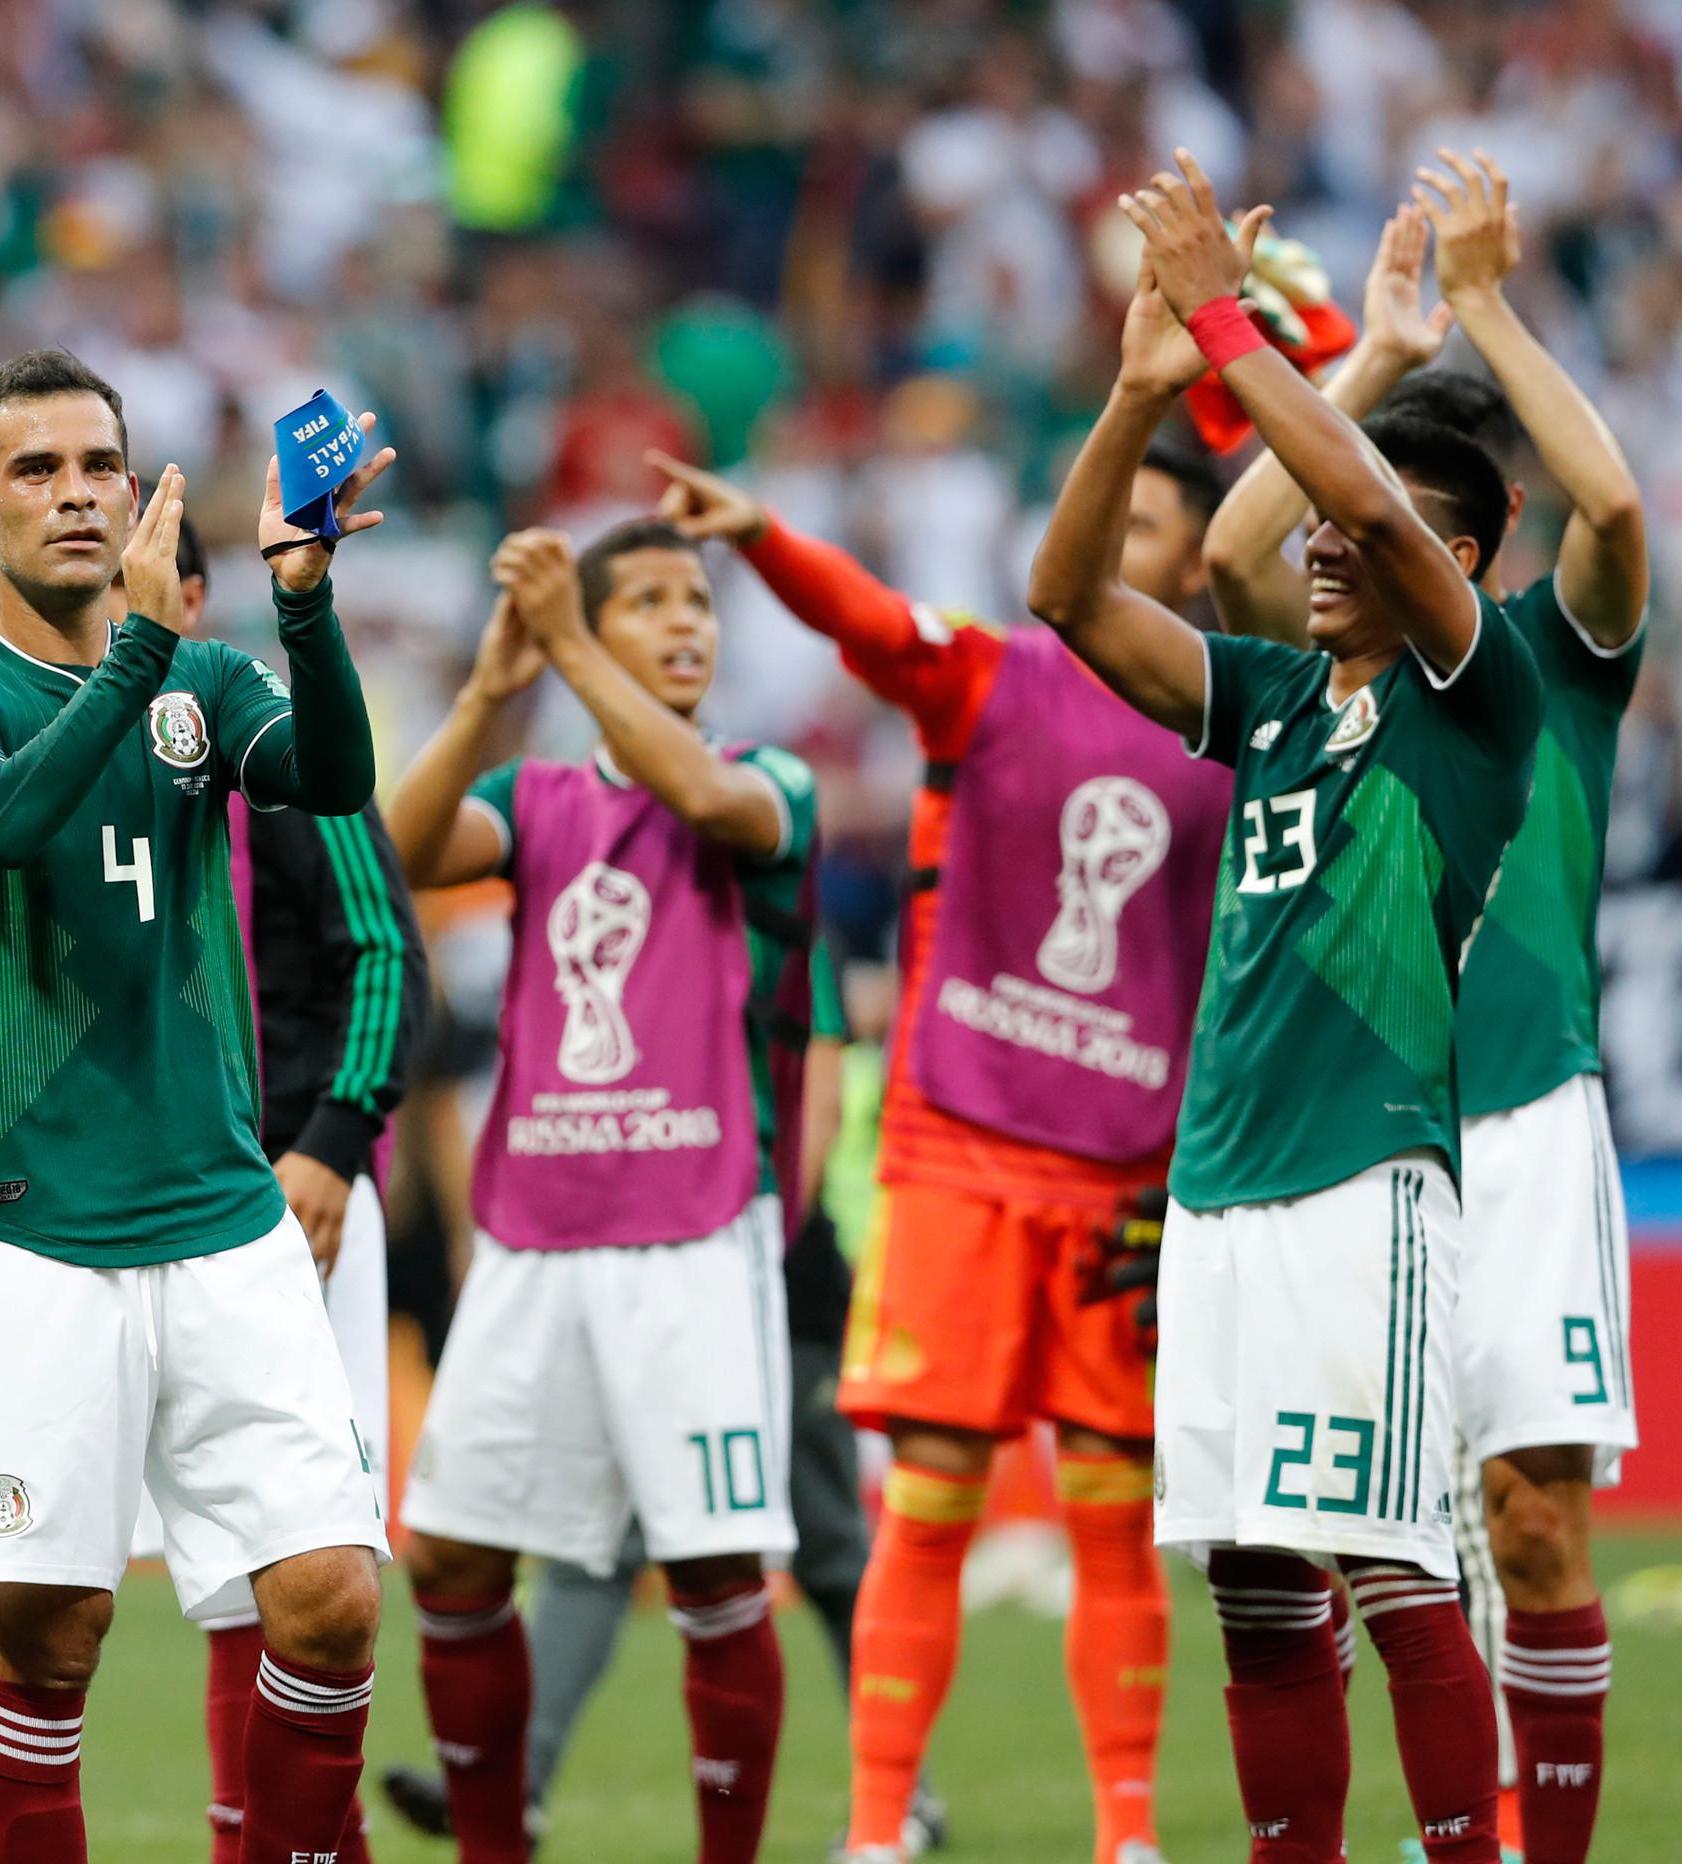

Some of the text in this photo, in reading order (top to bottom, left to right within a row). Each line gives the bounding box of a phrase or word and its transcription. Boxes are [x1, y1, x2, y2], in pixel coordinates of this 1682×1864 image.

[292, 414, 330, 443] FIFA
[102, 825, 155, 922] 4
[1236, 788, 1317, 893] 23
[624, 1106, 721, 1150] 2018
[1562, 1315, 1608, 1405] 9
[688, 1430, 766, 1514] 10
[1264, 1411, 1376, 1515] 23
[1536, 1762, 1592, 1788] FMF
